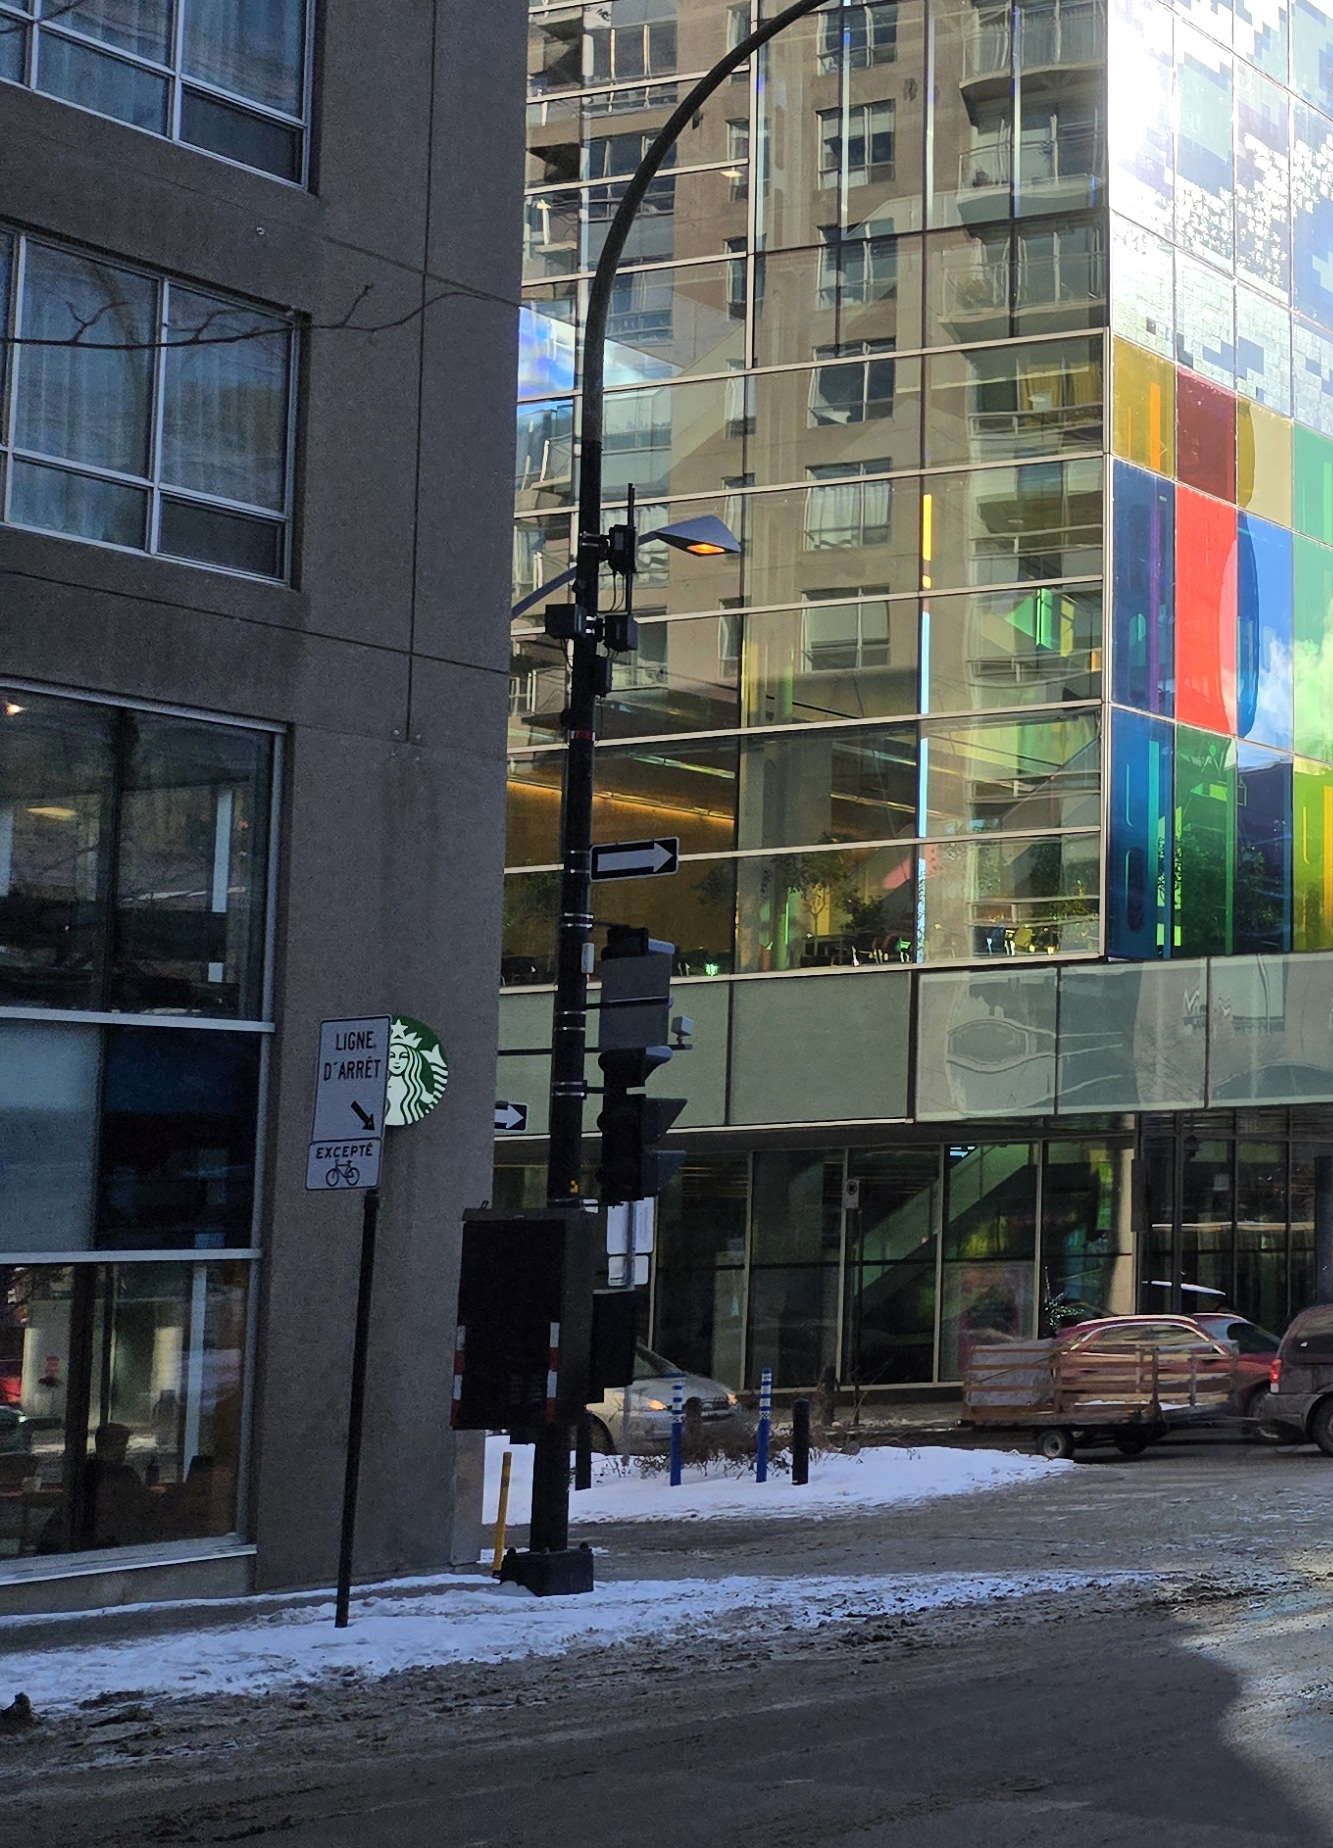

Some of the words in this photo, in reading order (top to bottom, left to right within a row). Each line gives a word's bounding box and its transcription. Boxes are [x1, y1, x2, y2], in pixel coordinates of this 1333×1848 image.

[335, 1030, 375, 1052] LIGNE
[323, 1055, 382, 1081] D'ARRÊT
[315, 1142, 374, 1160] EXCEPTÉ
